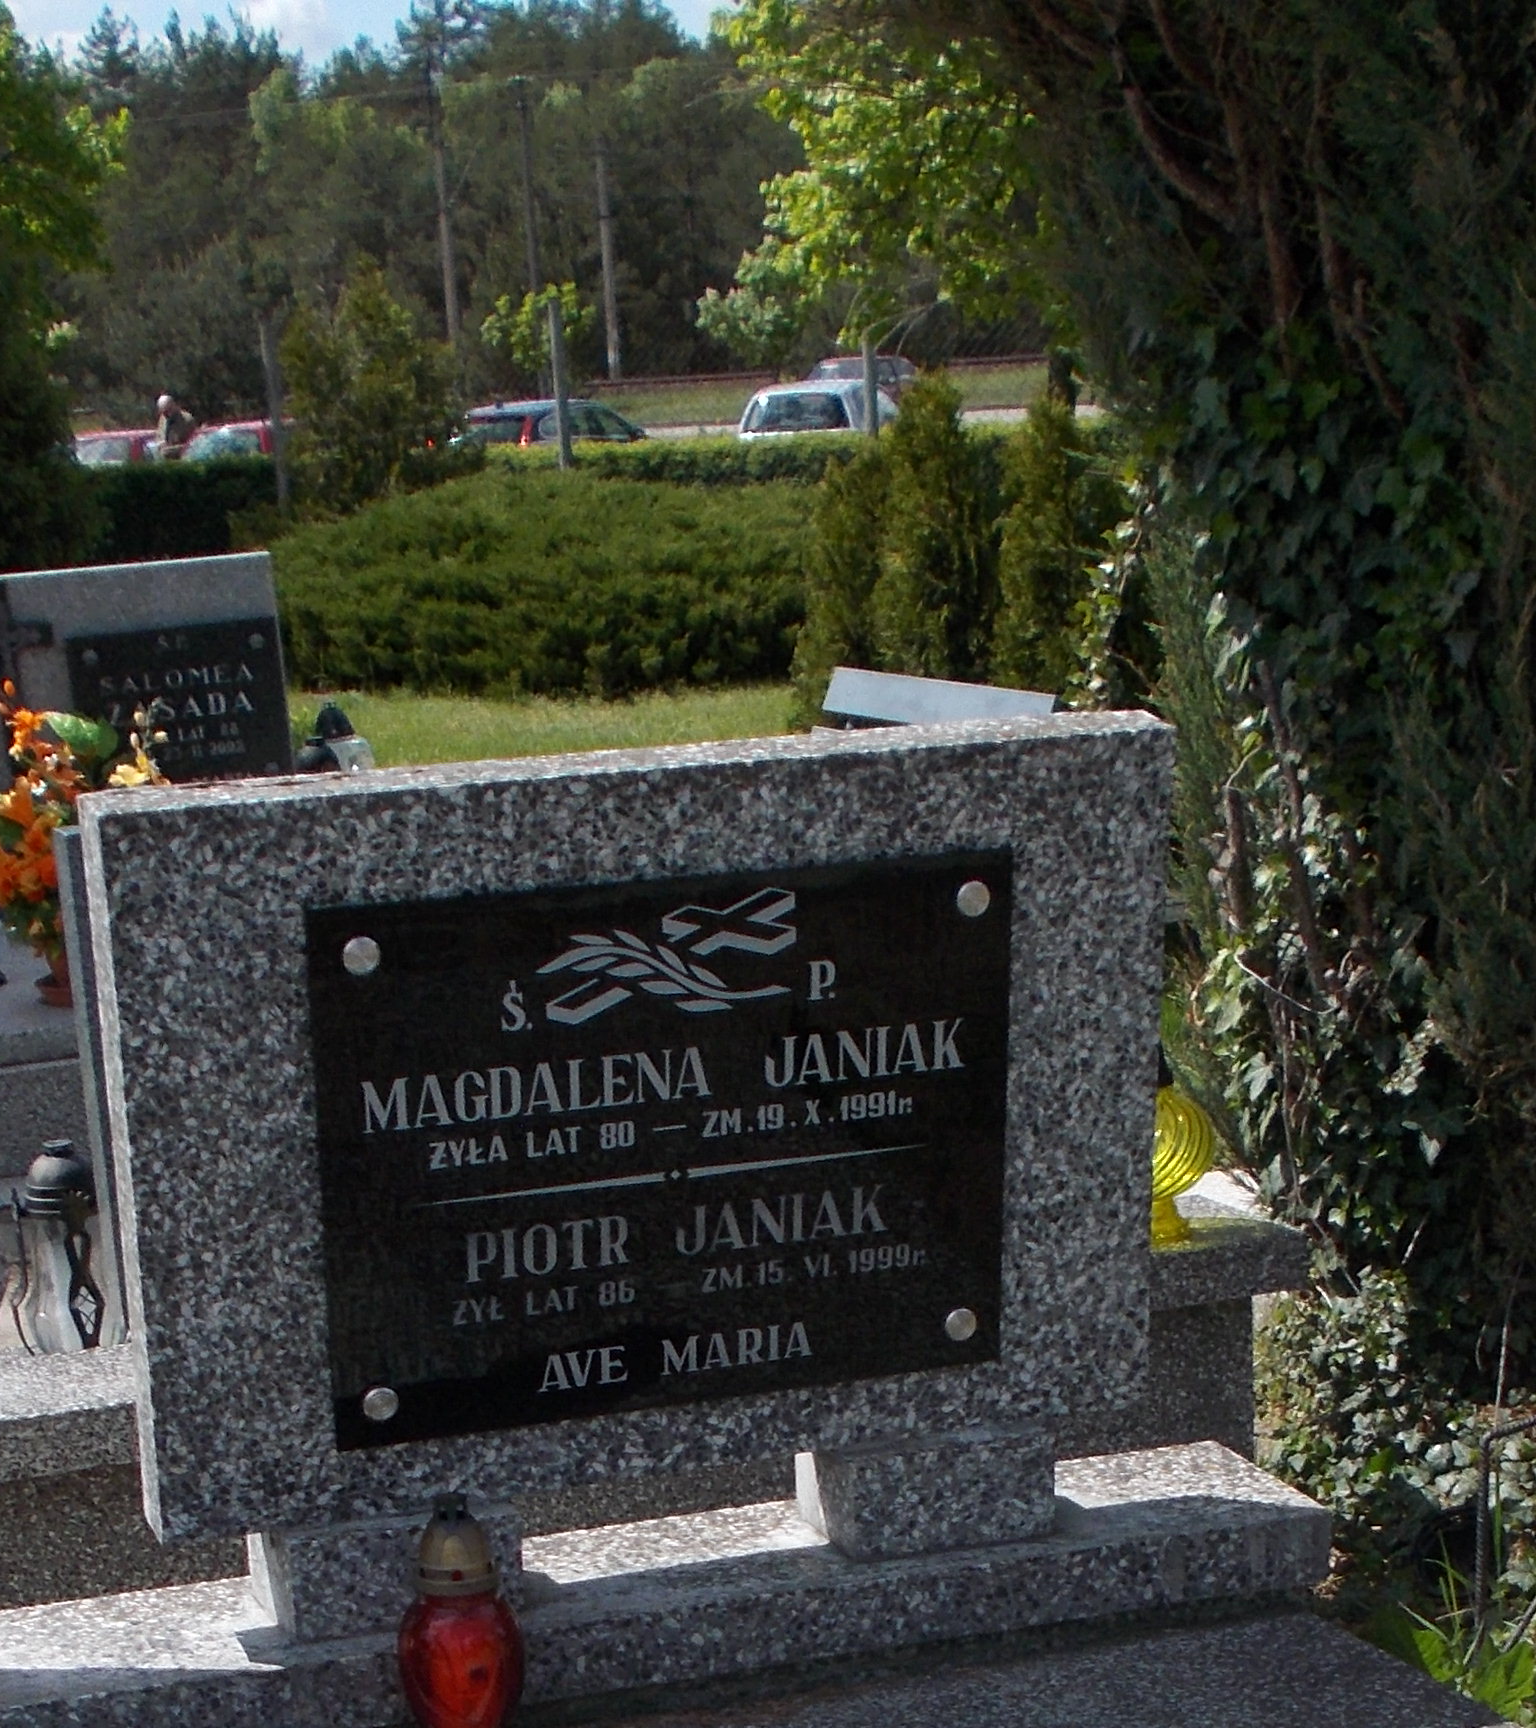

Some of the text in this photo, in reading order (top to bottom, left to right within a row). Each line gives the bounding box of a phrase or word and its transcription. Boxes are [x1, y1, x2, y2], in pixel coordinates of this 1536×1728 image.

[99, 660, 255, 695] SALOMEA
[808, 959, 836, 1001] P.
[361, 1017, 964, 1134] MAGDALENA JANIAK
[526, 1126, 582, 1159] LAT
[599, 1120, 636, 1150] 80
[465, 1184, 889, 1284] PIOTR JANIAK
[525, 1285, 580, 1316] LAT
[598, 1279, 636, 1308] 86
[538, 1321, 814, 1393] AVE MARIA
